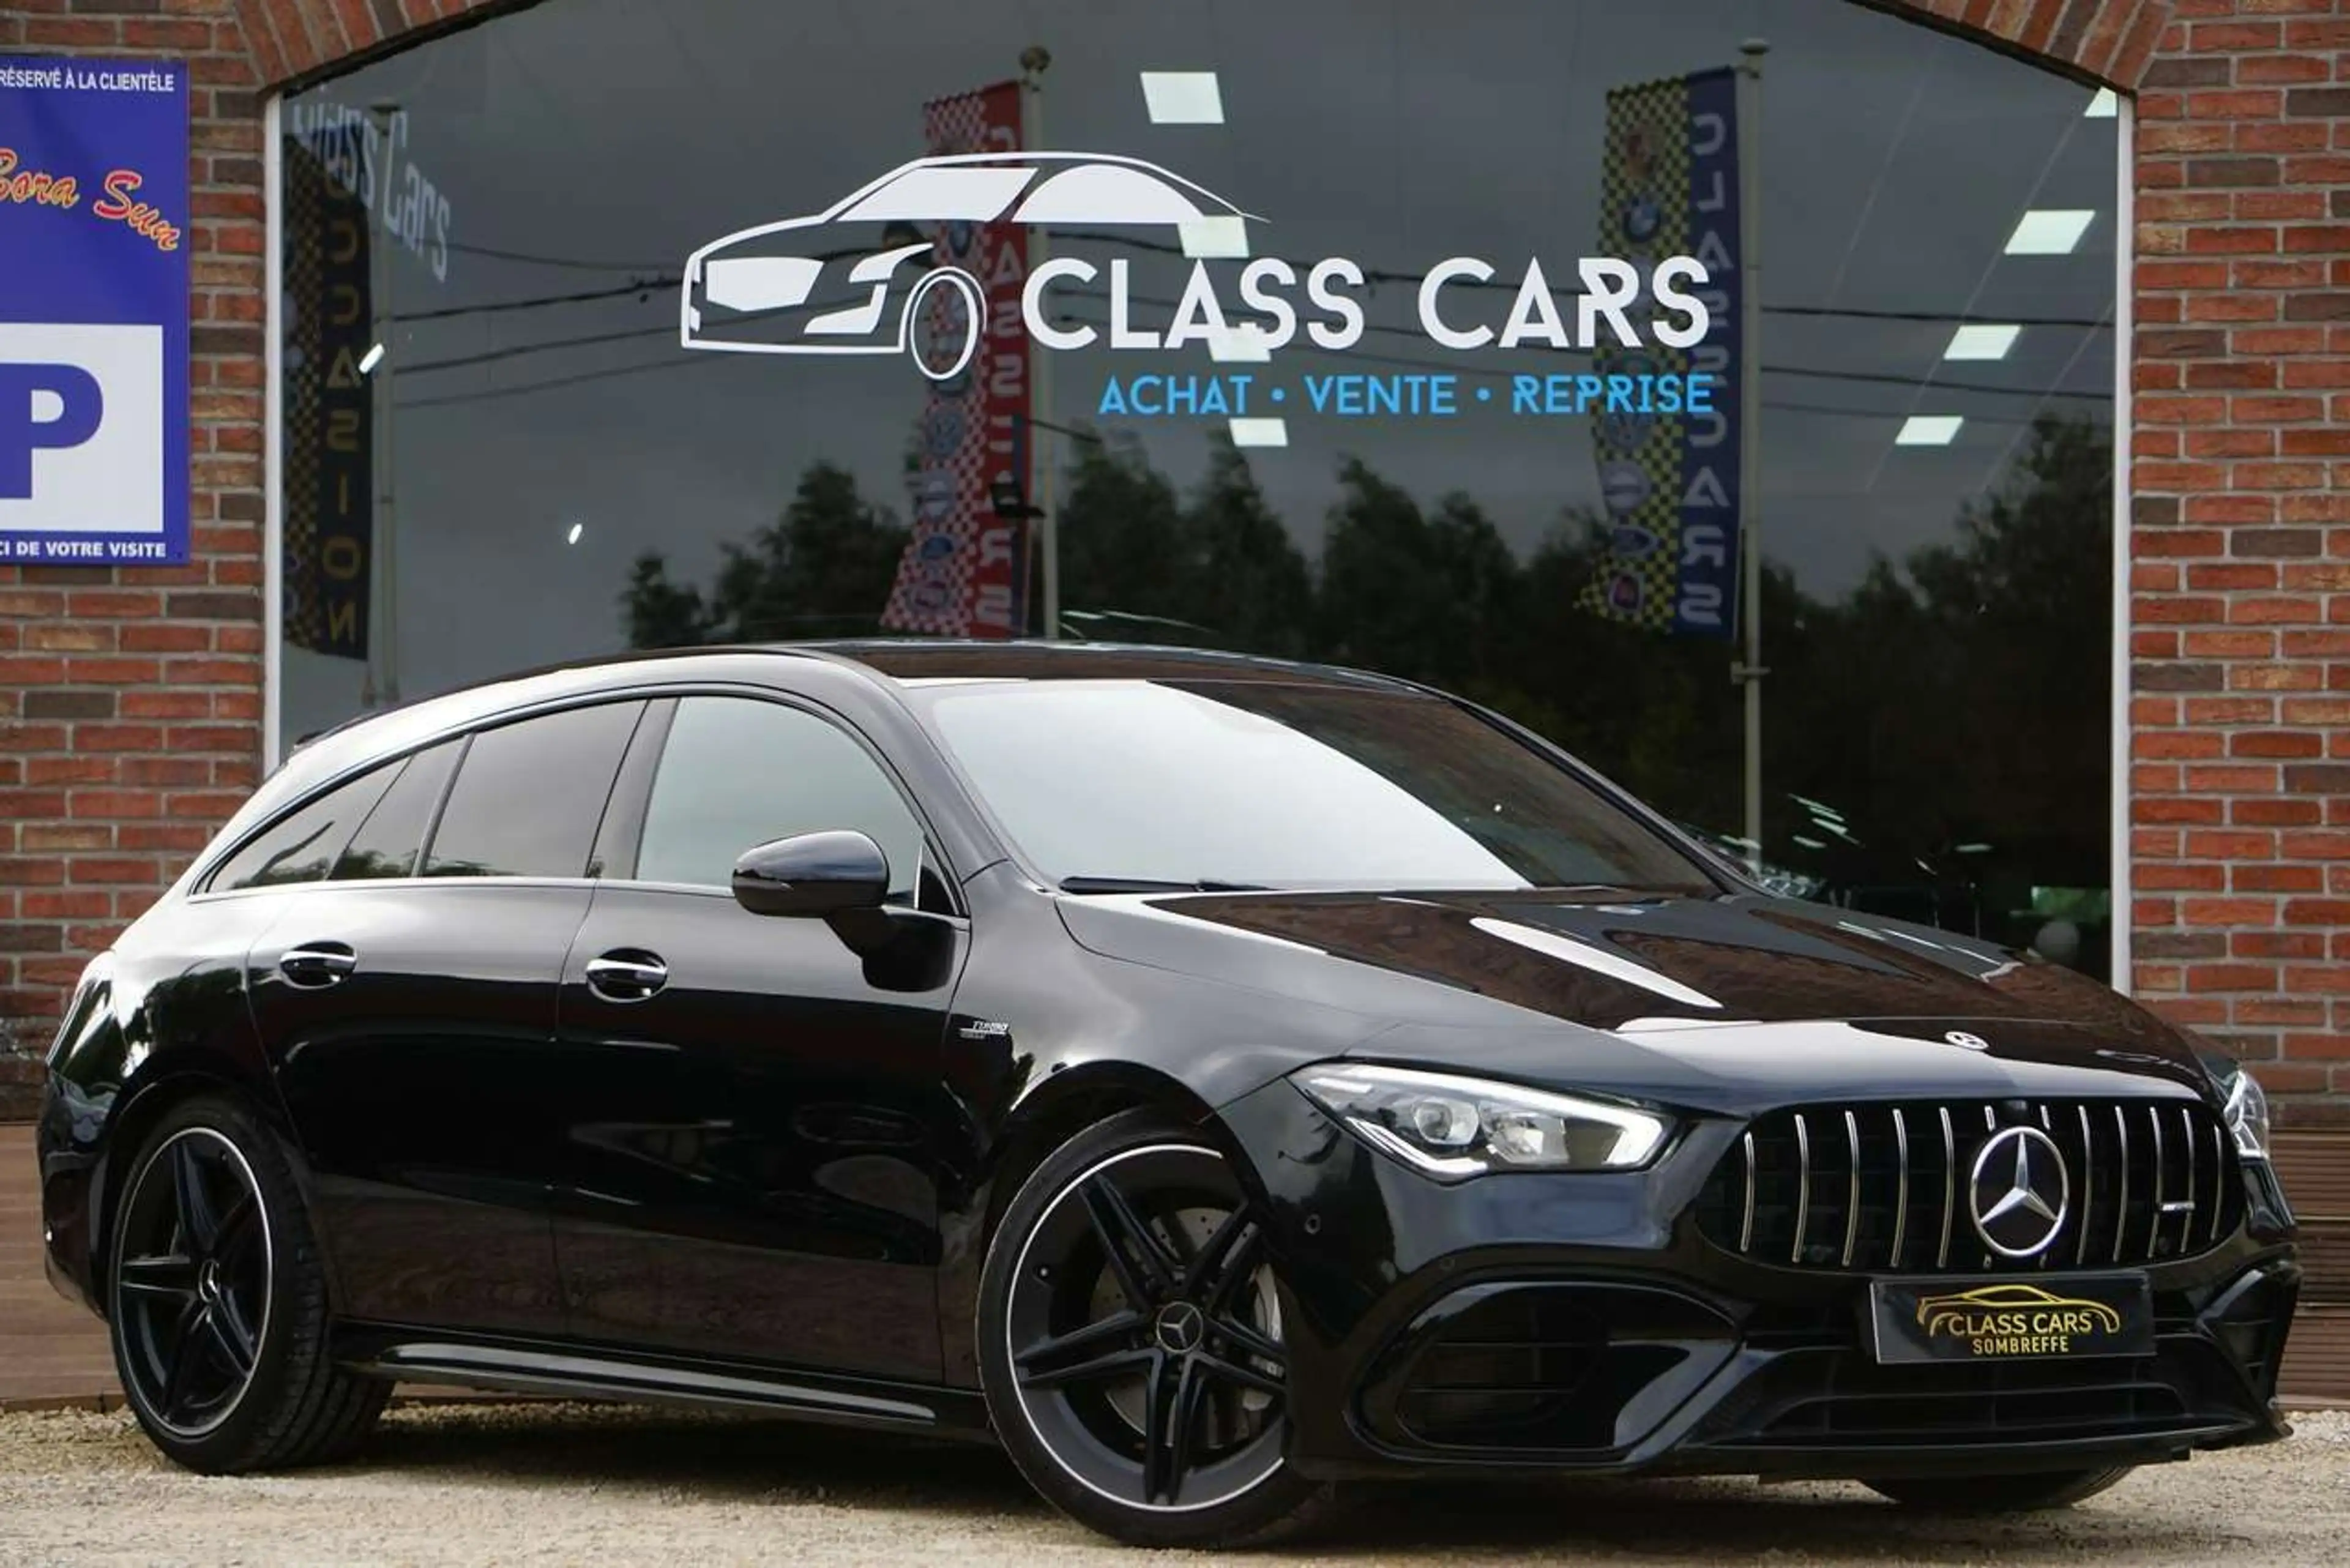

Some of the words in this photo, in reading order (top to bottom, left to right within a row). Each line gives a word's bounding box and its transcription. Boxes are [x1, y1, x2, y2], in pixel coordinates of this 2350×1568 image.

[64, 67, 76, 89] À
[78, 72, 98, 90] LA
[99, 69, 175, 92] CLIENTÈLE
[93, 170, 181, 252] Sun
[1022, 257, 1365, 350] CLASS
[1418, 255, 1710, 349] CARS
[1099, 374, 1253, 414] ACHAT
[1304, 374, 1457, 414] VENTE
[1512, 374, 1714, 414] REPRISE
[0, 363, 104, 499] P
[15, 540, 40, 556] DE
[45, 541, 104, 557] VOTRE
[108, 542, 166, 558] VISITE
[1947, 1313, 2027, 1336] CLASS
[2032, 1312, 2093, 1334] CARS
[1972, 1335, 2069, 1355] SOMBREFFE
